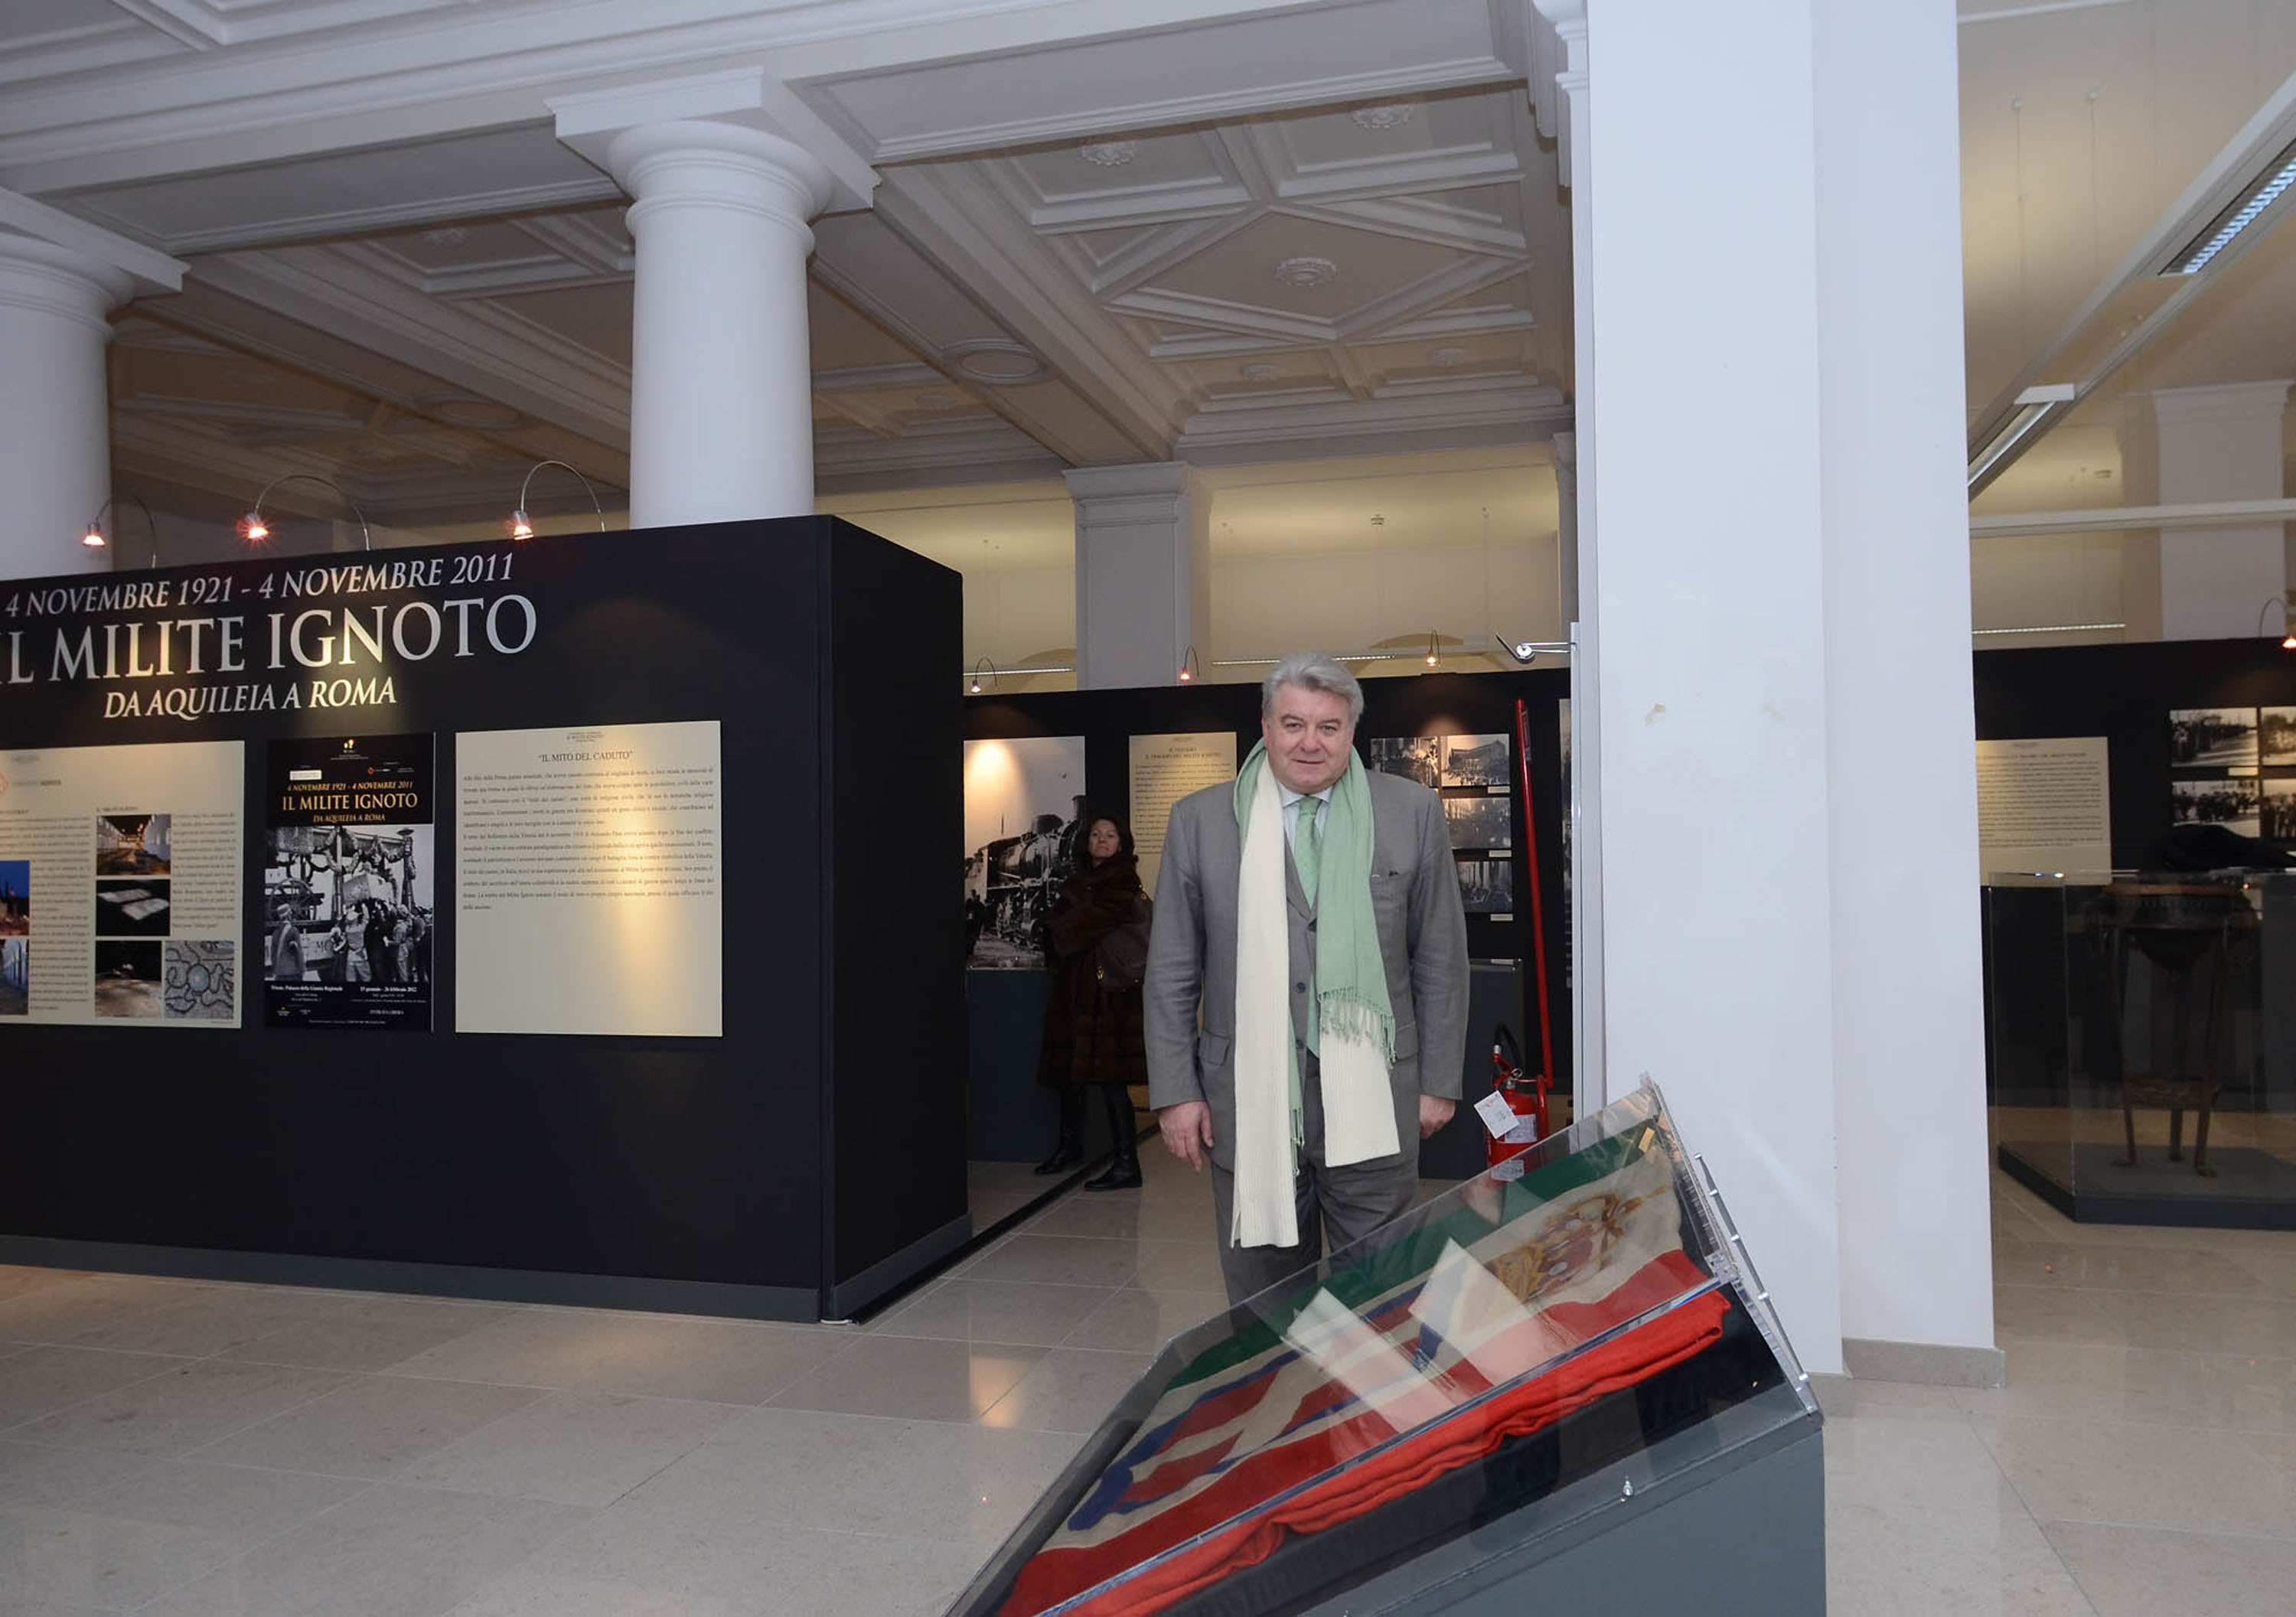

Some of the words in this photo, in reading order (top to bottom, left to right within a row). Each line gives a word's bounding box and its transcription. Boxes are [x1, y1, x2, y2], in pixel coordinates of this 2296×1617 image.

[6, 593, 18, 617] 4
[27, 580, 169, 616] NOVEMBRE
[178, 575, 233, 604] 1921
[259, 572, 274, 600] 4
[281, 559, 443, 598] NOVEMBRE
[450, 553, 514, 585] 2011
[0, 631, 34, 684] L
[48, 615, 246, 682] MILITE
[267, 594, 537, 670] IGNOTO
[104, 690, 141, 719] DA
[145, 683, 276, 721] AQUILEIA
[281, 681, 302, 709] A
[309, 676, 397, 709] ROMA
[552, 752, 574, 761] MITO
[576, 752, 592, 761] DEL
[292, 783, 330, 792] NOVEMBRE
[331, 783, 346, 791] 1921
[357, 782, 396, 791] NOVEMBRE
[397, 781, 414, 790] 2011
[282, 796, 295, 810] IL
[299, 794, 350, 810] MILITE
[354, 793, 419, 809] IGNOTO
[325, 813, 357, 823] AQUILEIA
[364, 813, 386, 821] ROMA
